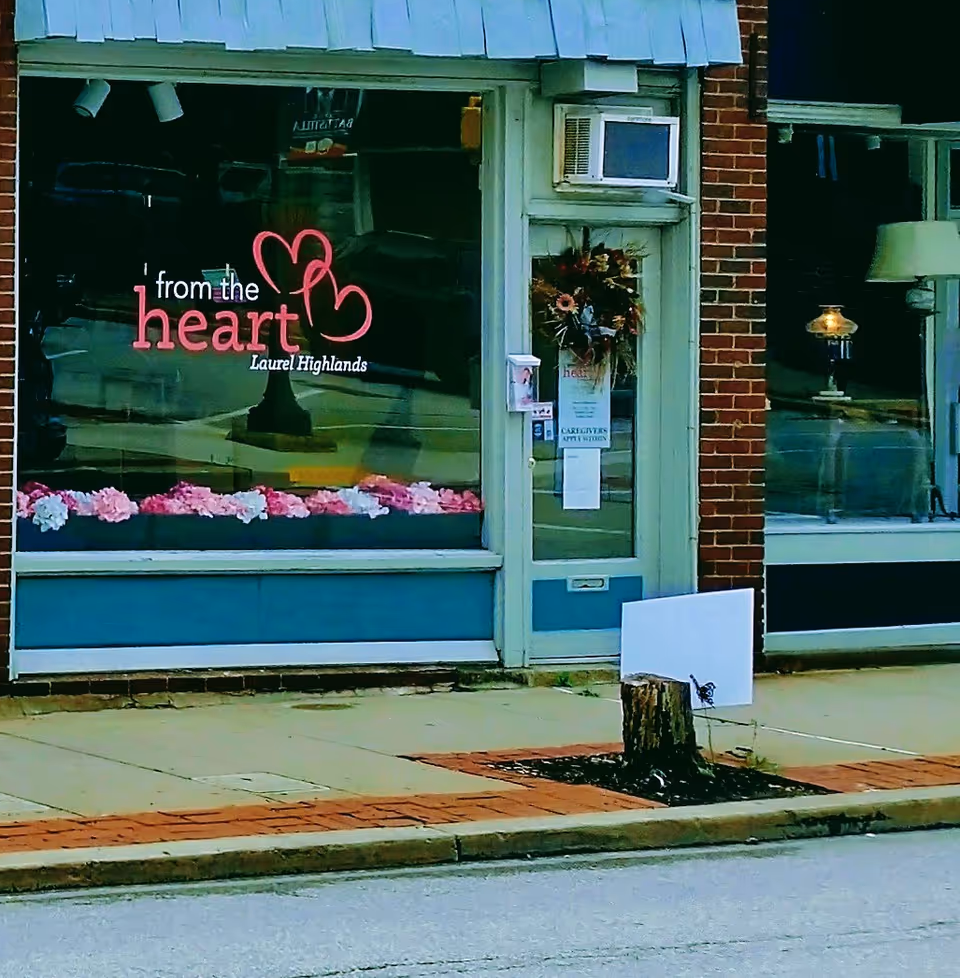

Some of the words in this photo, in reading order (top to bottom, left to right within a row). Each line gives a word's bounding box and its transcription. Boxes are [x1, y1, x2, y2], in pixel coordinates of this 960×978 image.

[156, 270, 212, 300] from
[220, 273, 260, 301] the
[133, 285, 300, 353] heart
[250, 354, 295, 371] Laurel
[297, 355, 368, 376] Highlands
[561, 427, 608, 435] CAREGIVERS
[562, 435, 581, 443] APPLY
